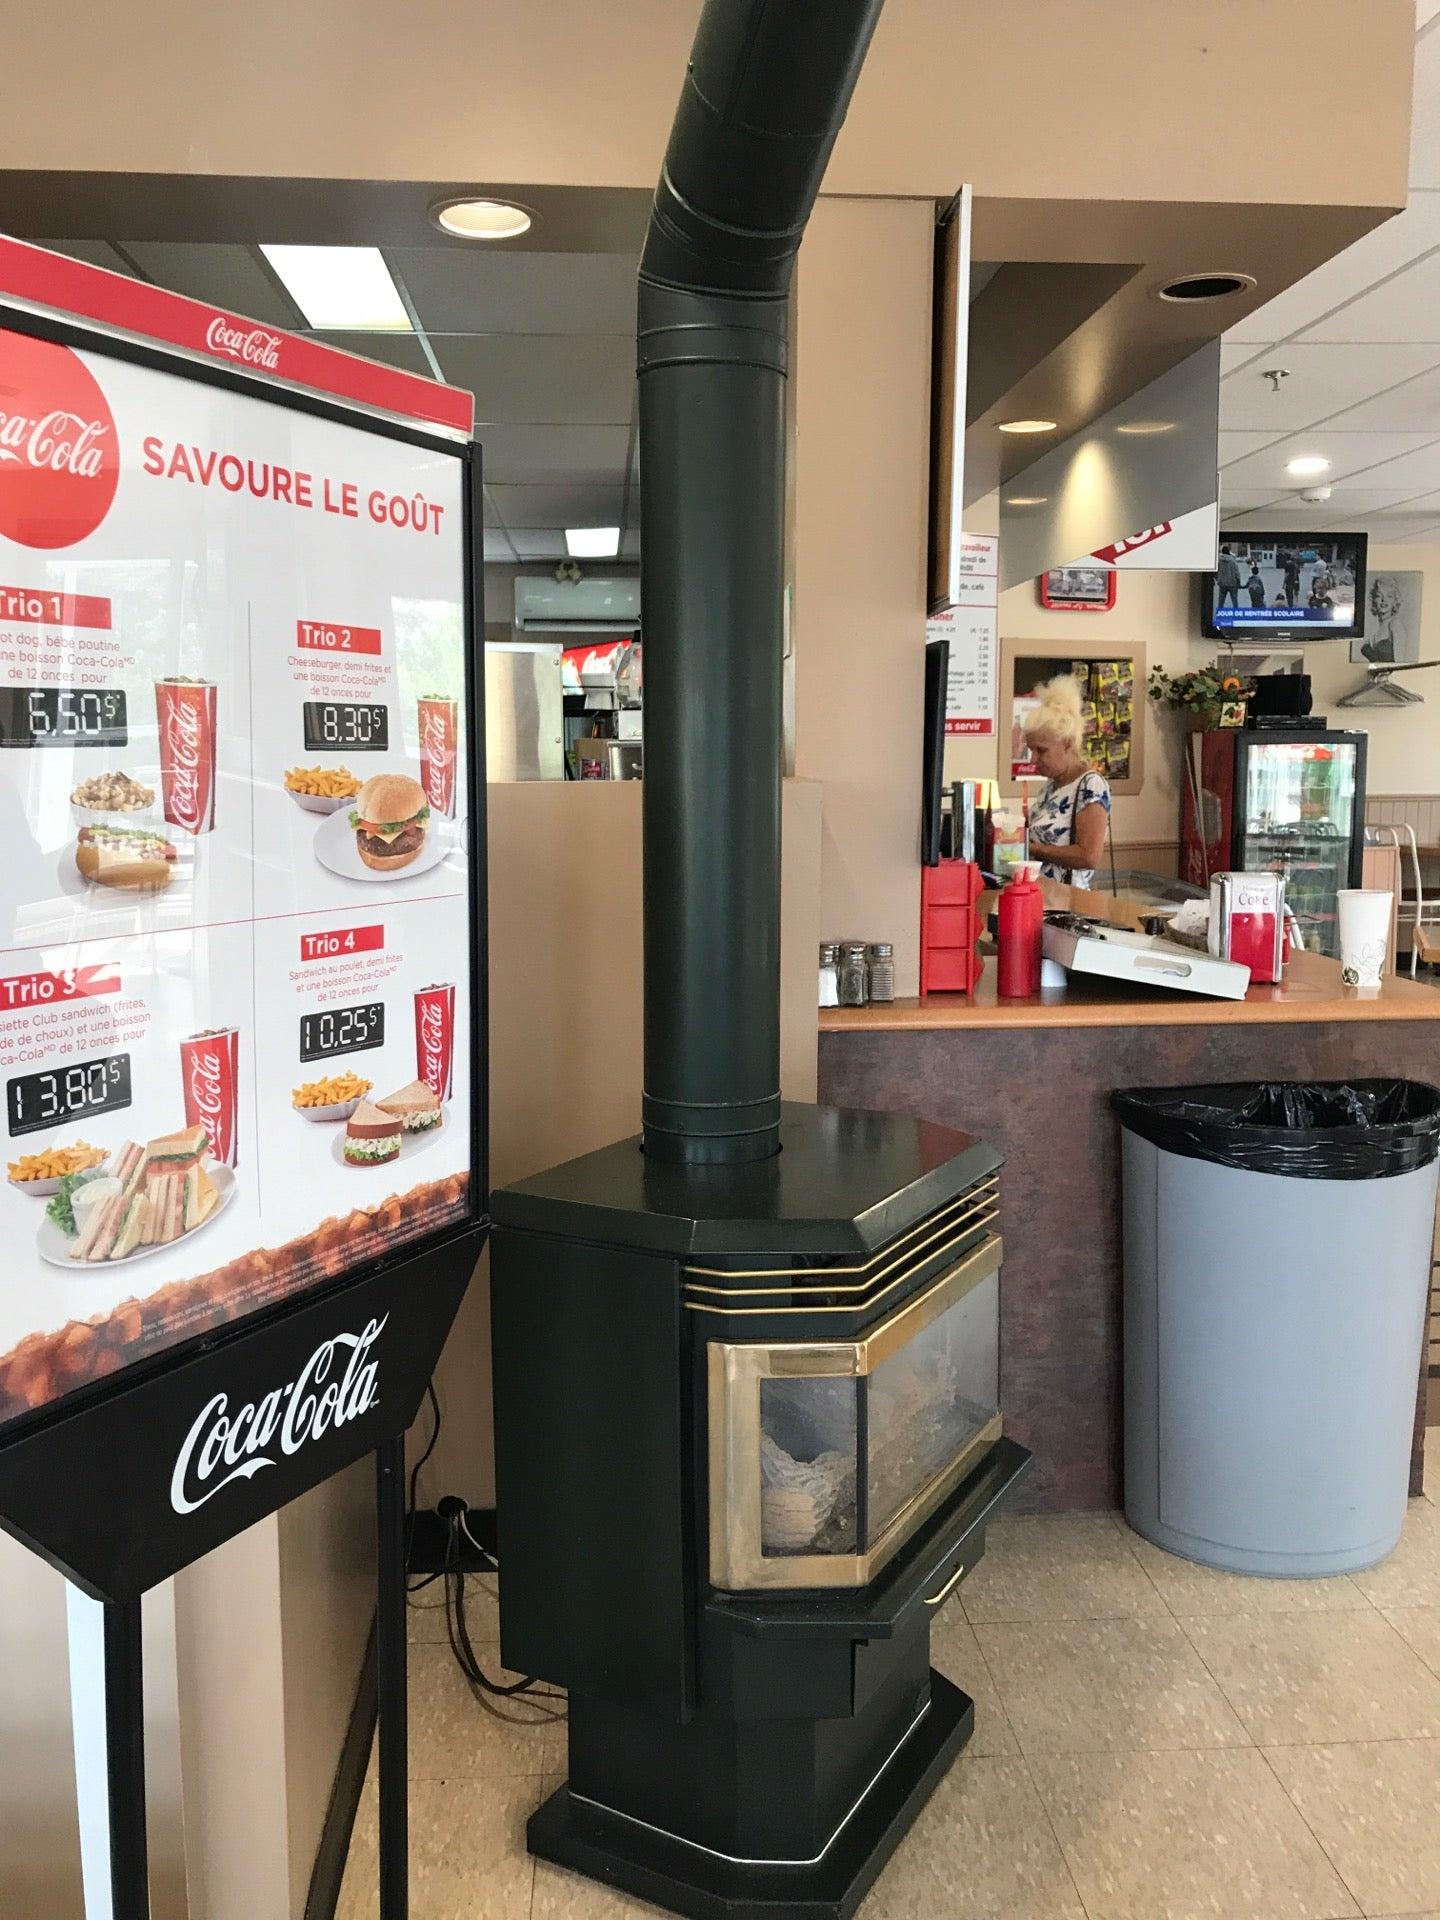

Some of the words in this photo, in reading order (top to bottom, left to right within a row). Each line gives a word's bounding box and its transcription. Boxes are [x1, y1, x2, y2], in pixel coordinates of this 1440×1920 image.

[206, 317, 283, 369] Coca-Cola
[0, 410, 111, 478] a-Cola
[143, 437, 313, 508] SAVOURE
[325, 478, 358, 518] LE
[369, 491, 445, 535] GOÛT
[52, 596, 62, 620] 1
[78, 639, 120, 653] poutine
[302, 624, 336, 647] Trio
[341, 630, 352, 648] 2
[19, 649, 64, 664] boisson
[8, 667, 23, 679] de
[26, 667, 37, 680] 12
[41, 671, 75, 682] onces
[81, 673, 108, 684] pour
[310, 671, 339, 683] boisson
[384, 666, 392, 674] et
[310, 685, 320, 695] de
[322, 686, 329, 696] 12
[330, 688, 353, 697] onces
[354, 690, 372, 699] pour
[1239, 892, 1269, 906] Coke
[305, 934, 340, 956] Trio
[344, 931, 355, 950] 4
[289, 964, 327, 981] Sandwich
[328, 965, 338, 974] au
[3, 976, 55, 1003] Trio
[296, 984, 305, 993] et
[322, 977, 352, 988] boisson
[317, 992, 327, 1002] de
[329, 990, 336, 1000] 12
[337, 987, 360, 998] onces
[362, 983, 379, 995] pour
[33, 1012, 58, 1027] Club
[61, 1004, 111, 1021] sandwich
[0, 1036, 14, 1049] de
[17, 1034, 32, 1047] de
[36, 1026, 74, 1043] choux)
[77, 1022, 88, 1035] et
[91, 1020, 110, 1033] une
[112, 1012, 151, 1029] boisson
[60, 1043, 73, 1055] de
[77, 1039, 87, 1051] 12
[90, 1036, 120, 1048] onces
[123, 1029, 147, 1045] pour
[170, 1311, 390, 1515] Coca-Cola
